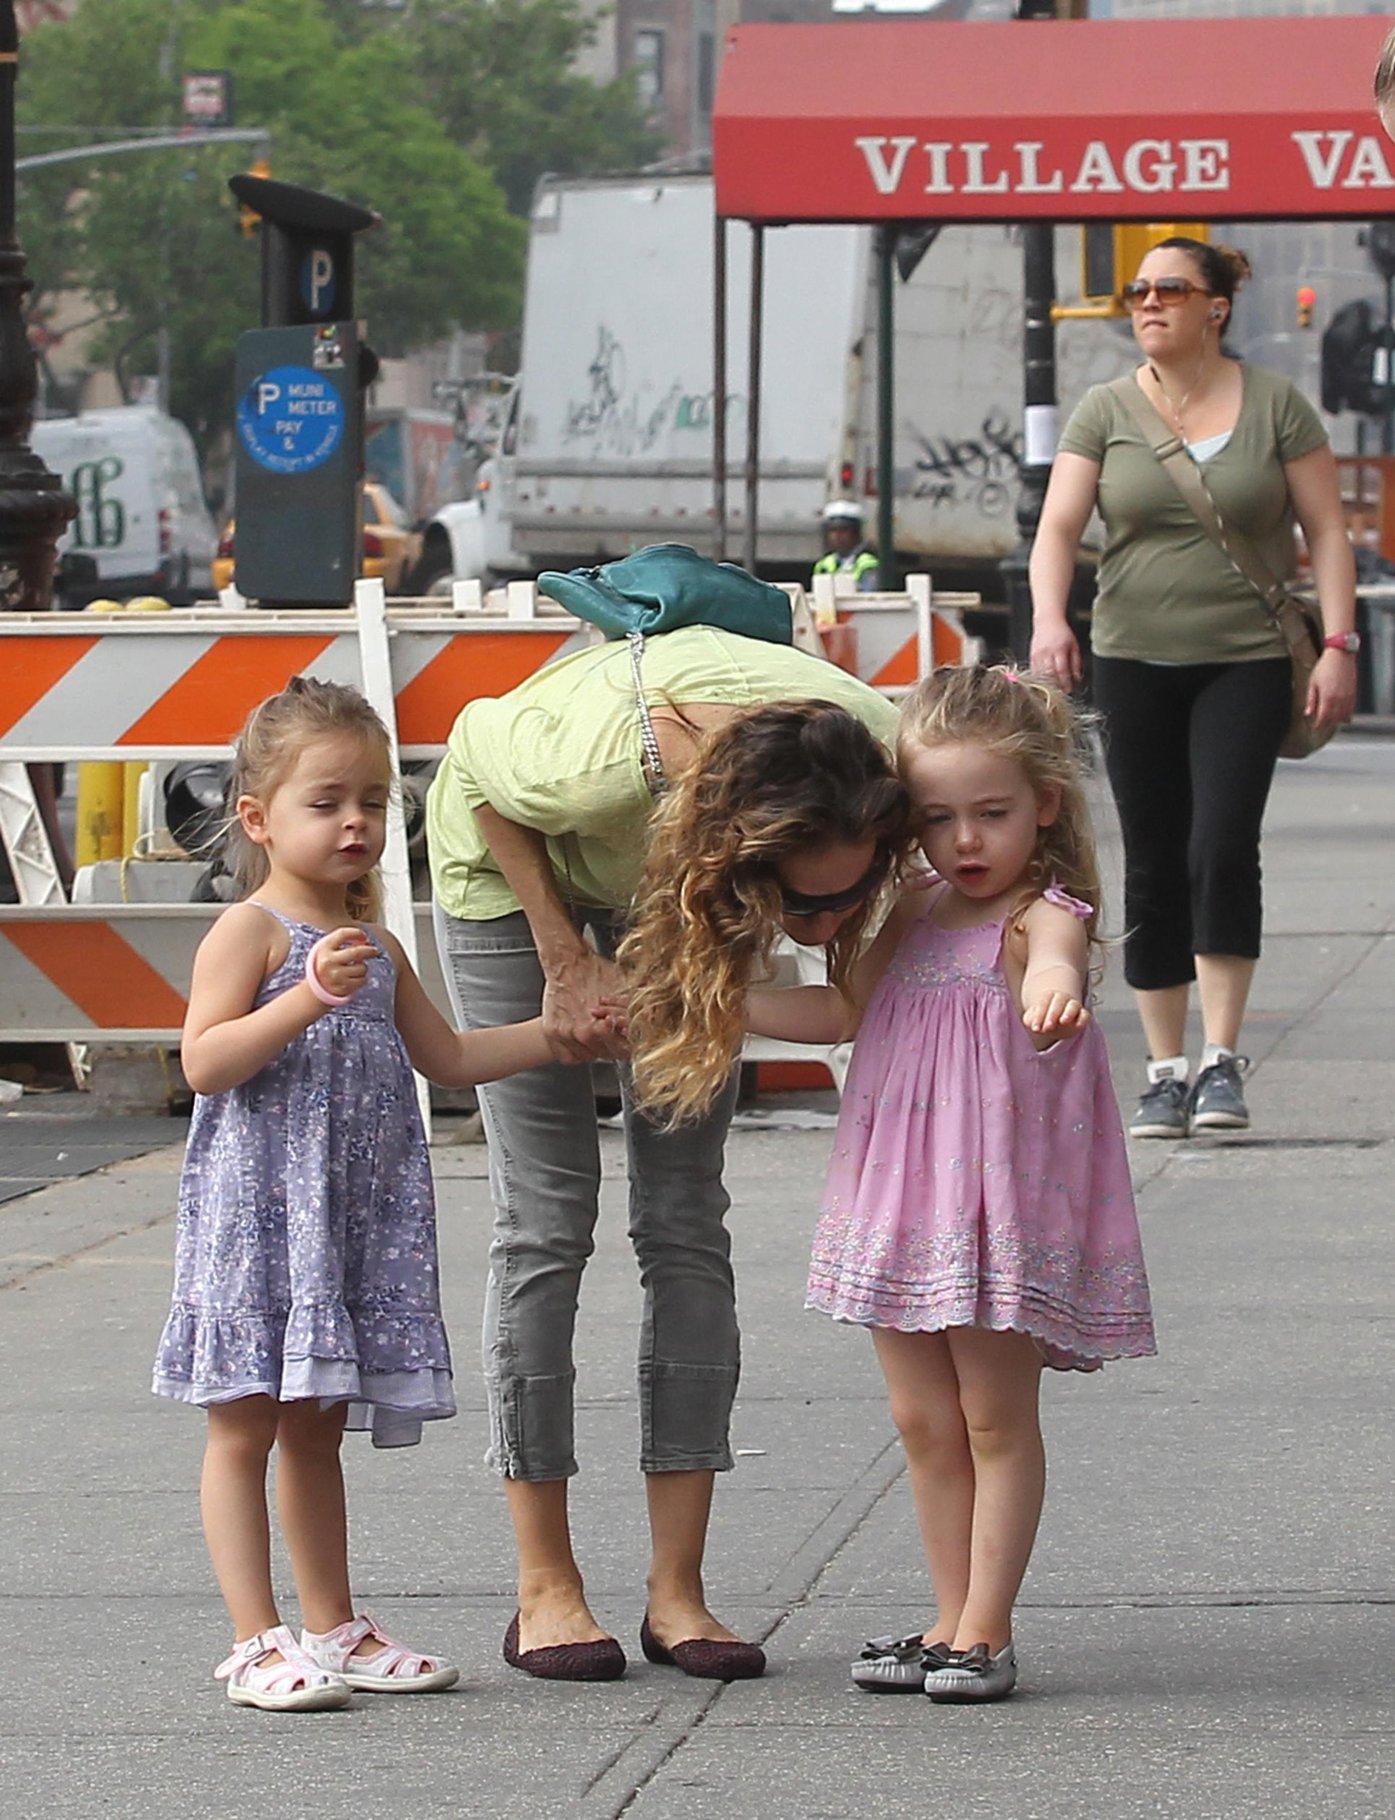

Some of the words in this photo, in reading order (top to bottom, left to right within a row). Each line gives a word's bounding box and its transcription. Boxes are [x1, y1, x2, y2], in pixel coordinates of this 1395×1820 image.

[854, 135, 1230, 195] VILLAGE
[311, 249, 333, 311] P
[258, 383, 280, 415] P
[288, 384, 324, 397] MUNI
[288, 401, 337, 415] METER
[275, 420, 304, 434] PAY
